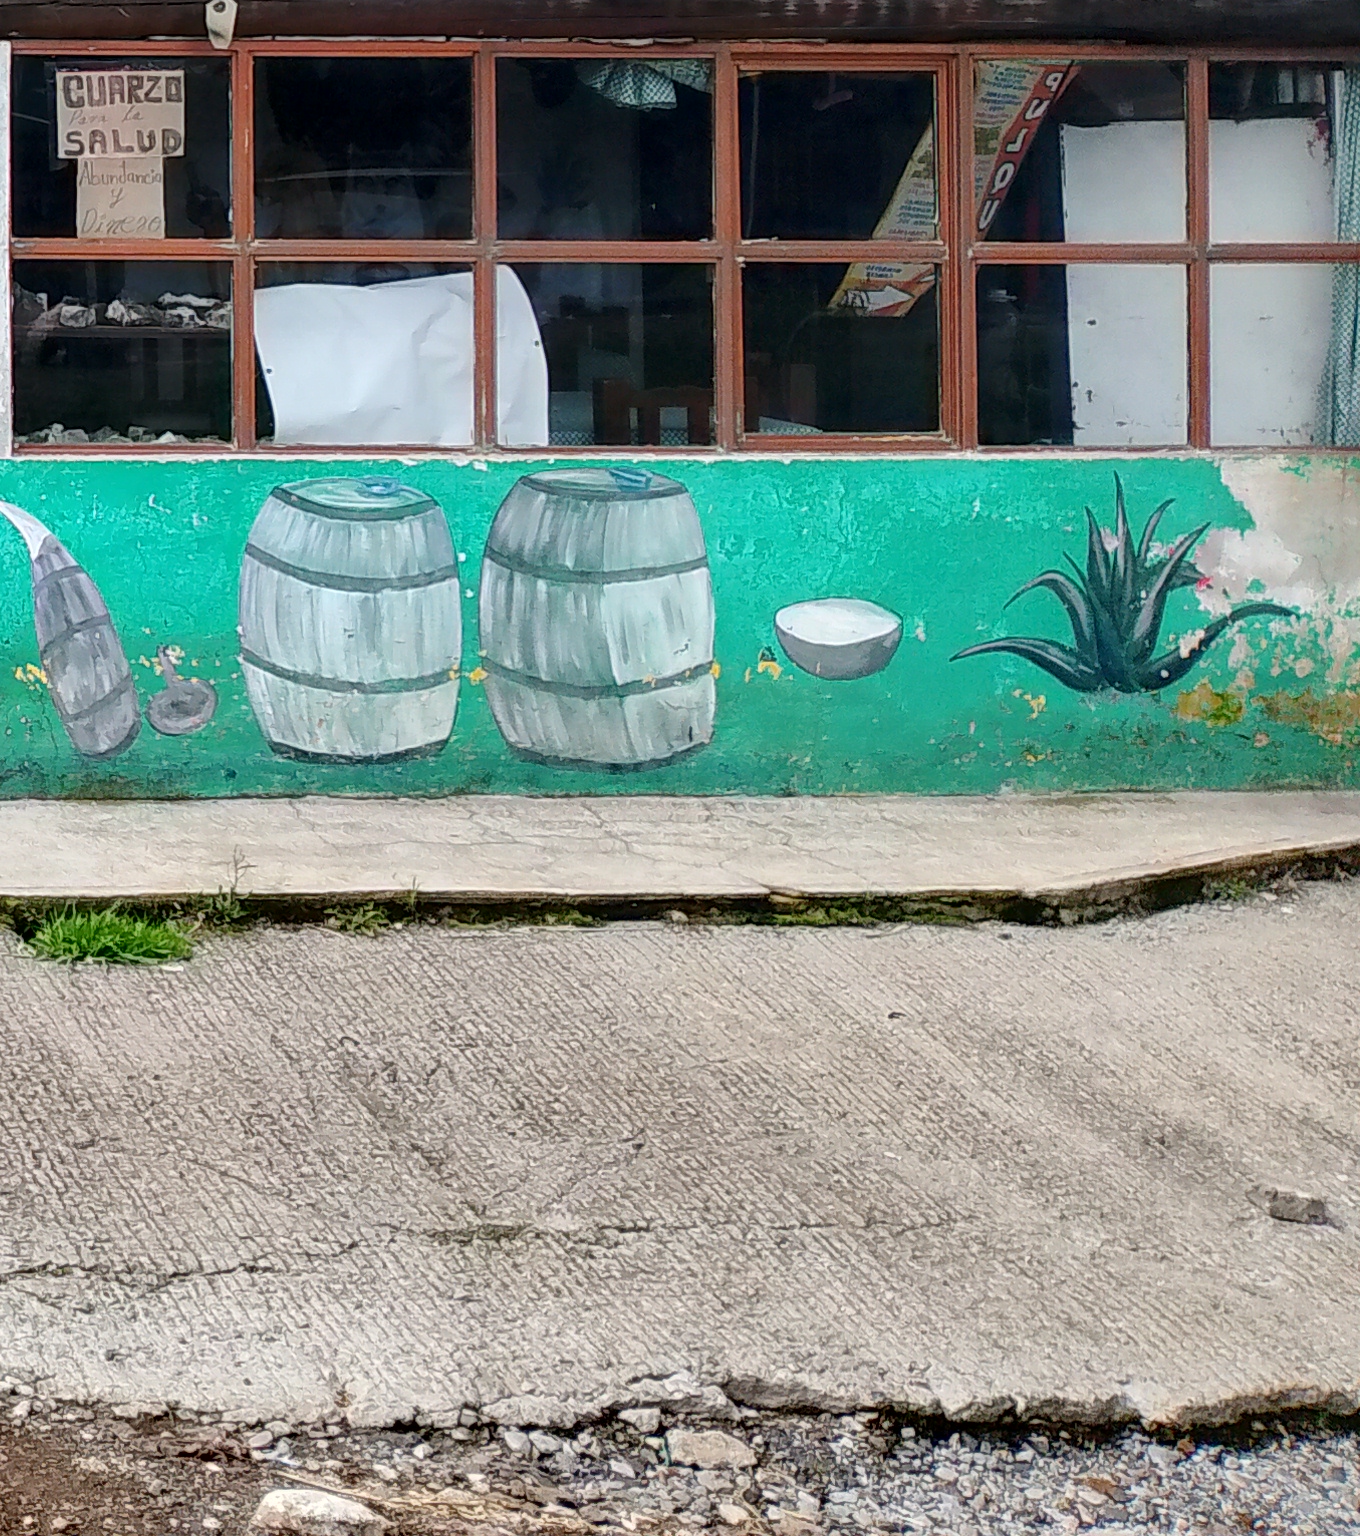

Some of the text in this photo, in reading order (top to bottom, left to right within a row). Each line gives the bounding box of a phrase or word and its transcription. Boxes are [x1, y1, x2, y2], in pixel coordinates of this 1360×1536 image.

[63, 75, 183, 108] CUARZO
[64, 128, 182, 156] SALUD
[78, 159, 162, 186] Abundancia
